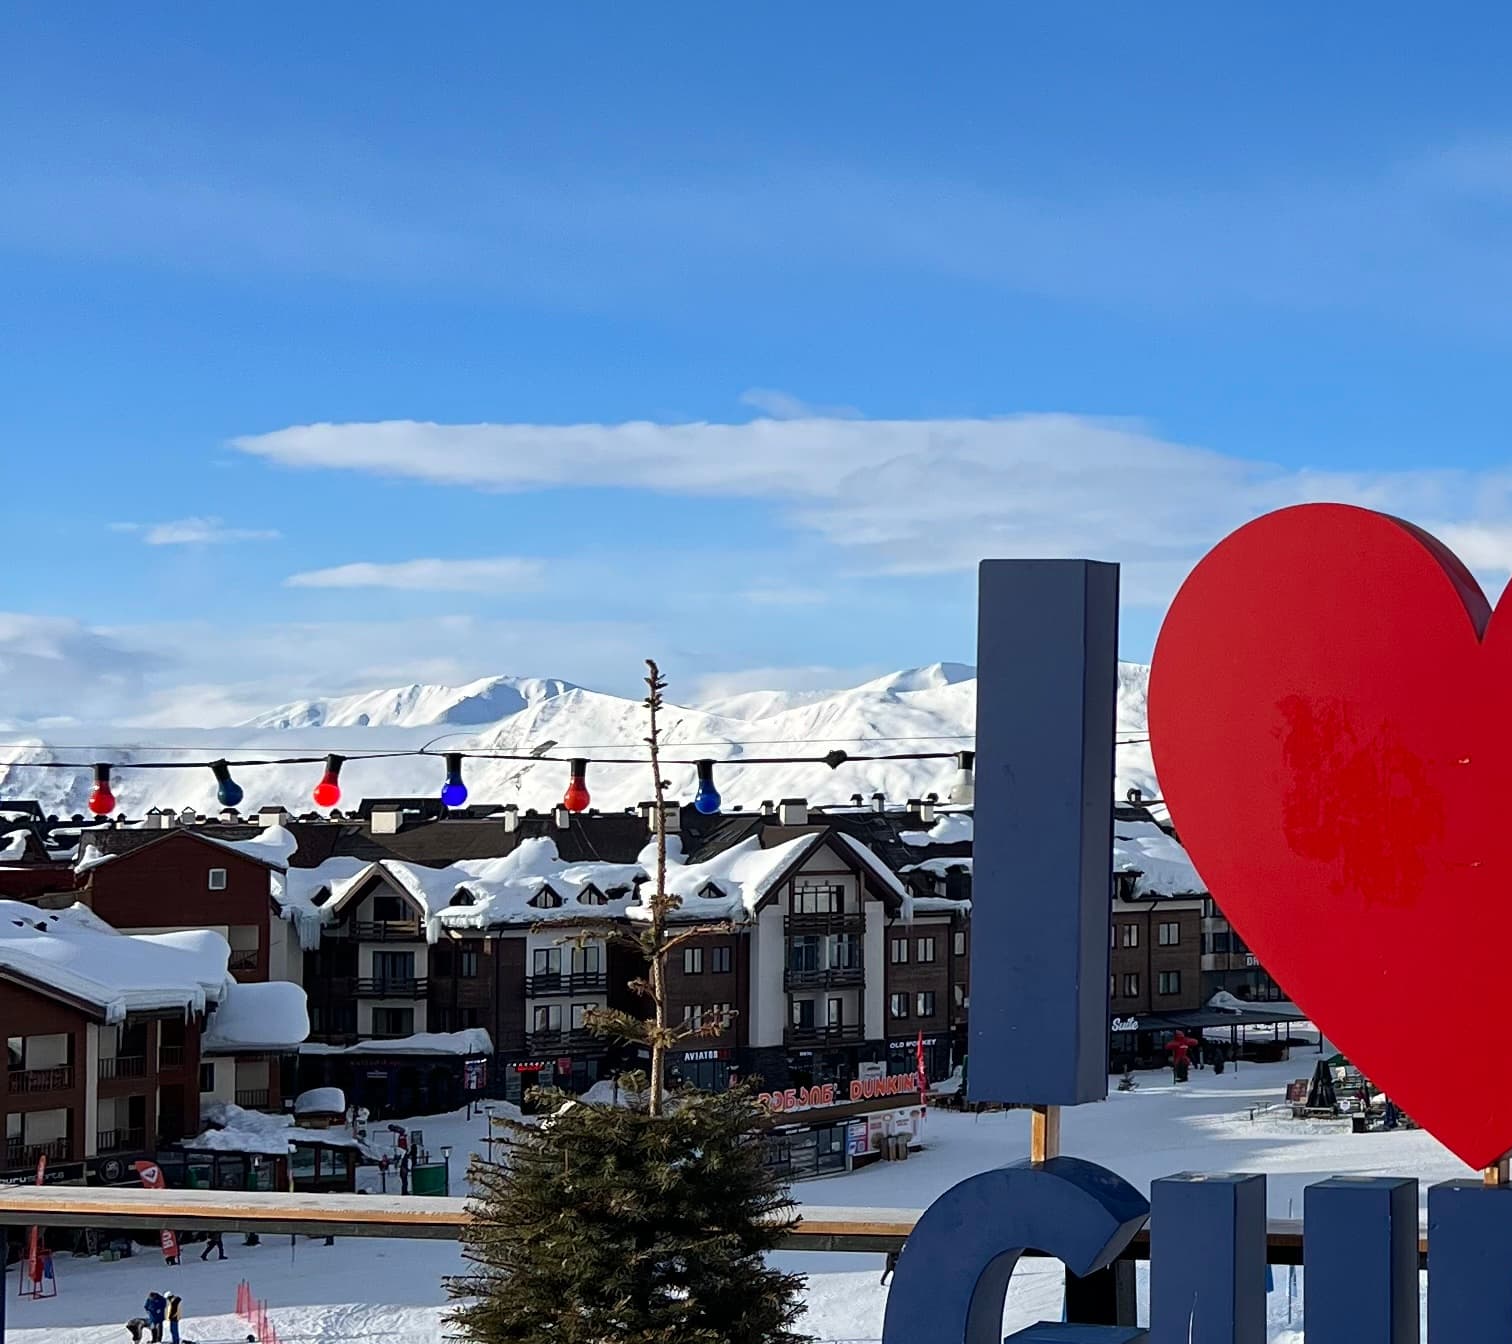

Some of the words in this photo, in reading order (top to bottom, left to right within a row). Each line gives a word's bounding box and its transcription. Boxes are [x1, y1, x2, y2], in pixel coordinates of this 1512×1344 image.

[967, 558, 1119, 1106] I
[1111, 1016, 1139, 1032] Suite
[889, 1041, 905, 1049] OLD
[905, 1038, 937, 1048] MOKEY
